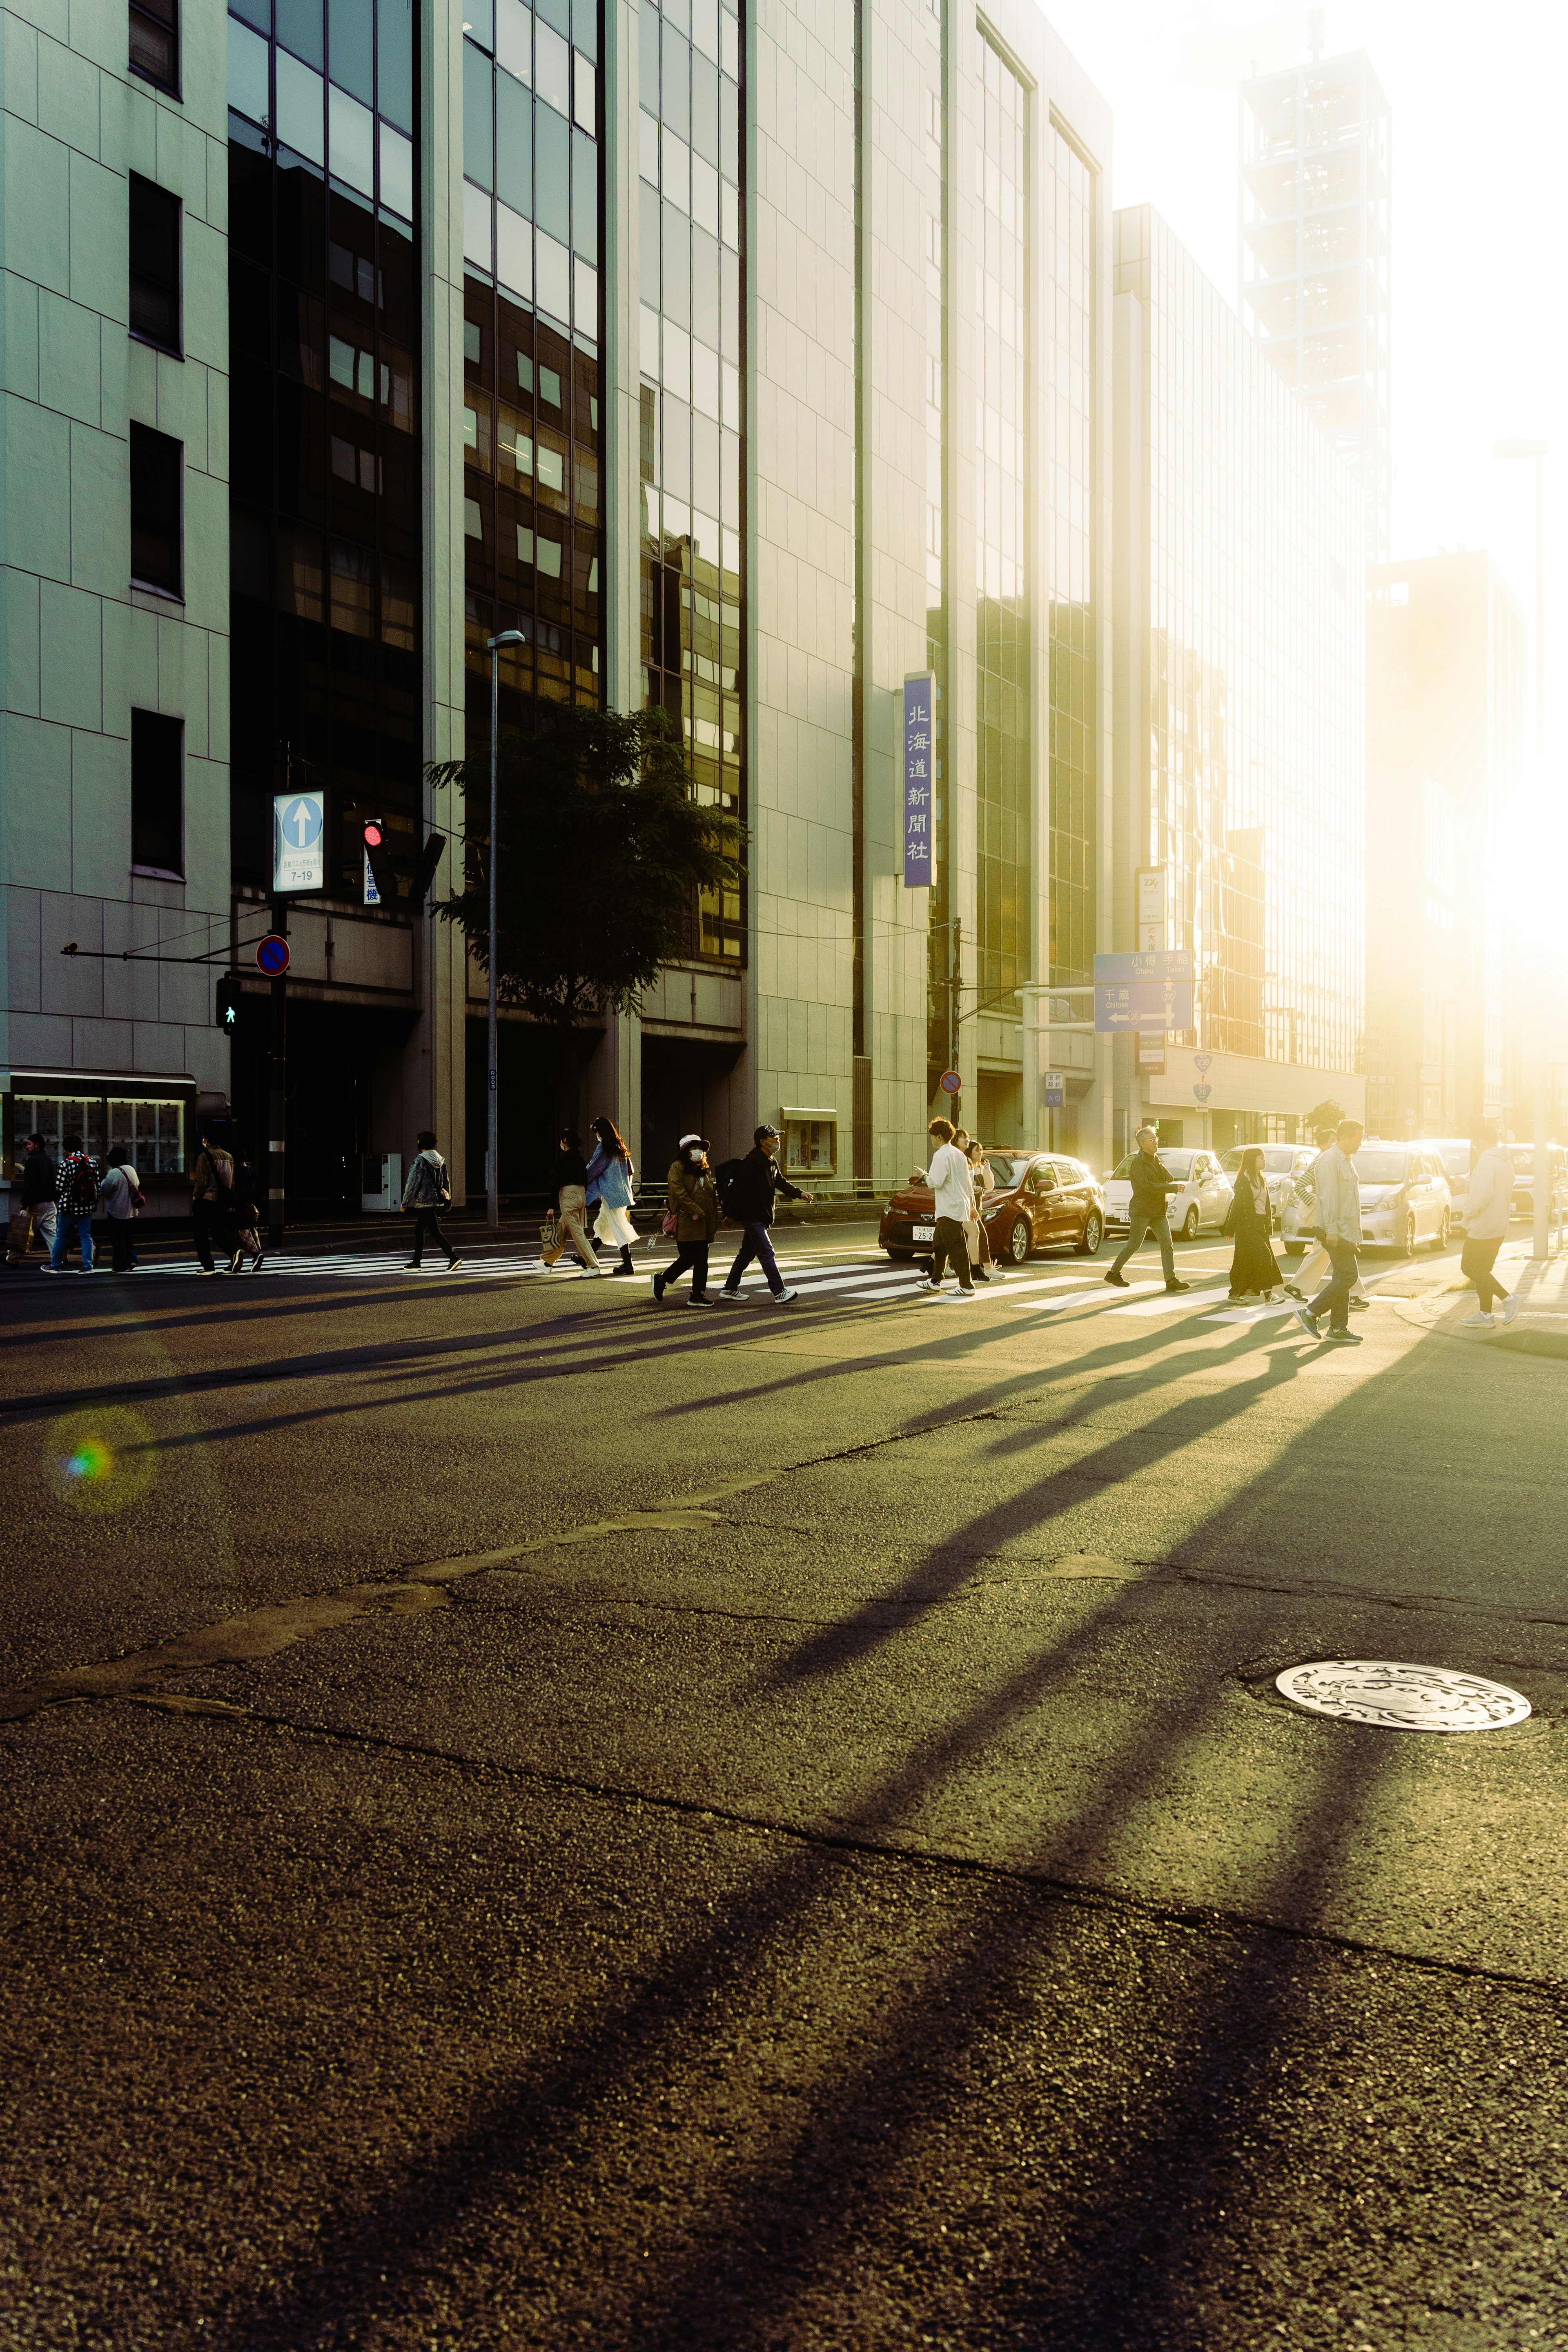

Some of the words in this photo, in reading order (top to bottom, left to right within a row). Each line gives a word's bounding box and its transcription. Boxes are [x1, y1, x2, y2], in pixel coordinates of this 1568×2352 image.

[906, 706, 931, 860] 北海道新聞社
[291, 871, 312, 882] 7-19
[1144, 878, 1159, 889] ZXY
[1148, 934, 1156, 951] 大塚
[1131, 954, 1156, 967] 小樽
[1163, 953, 1188, 965] 手稲
[1104, 989, 1129, 1001] 千歳
